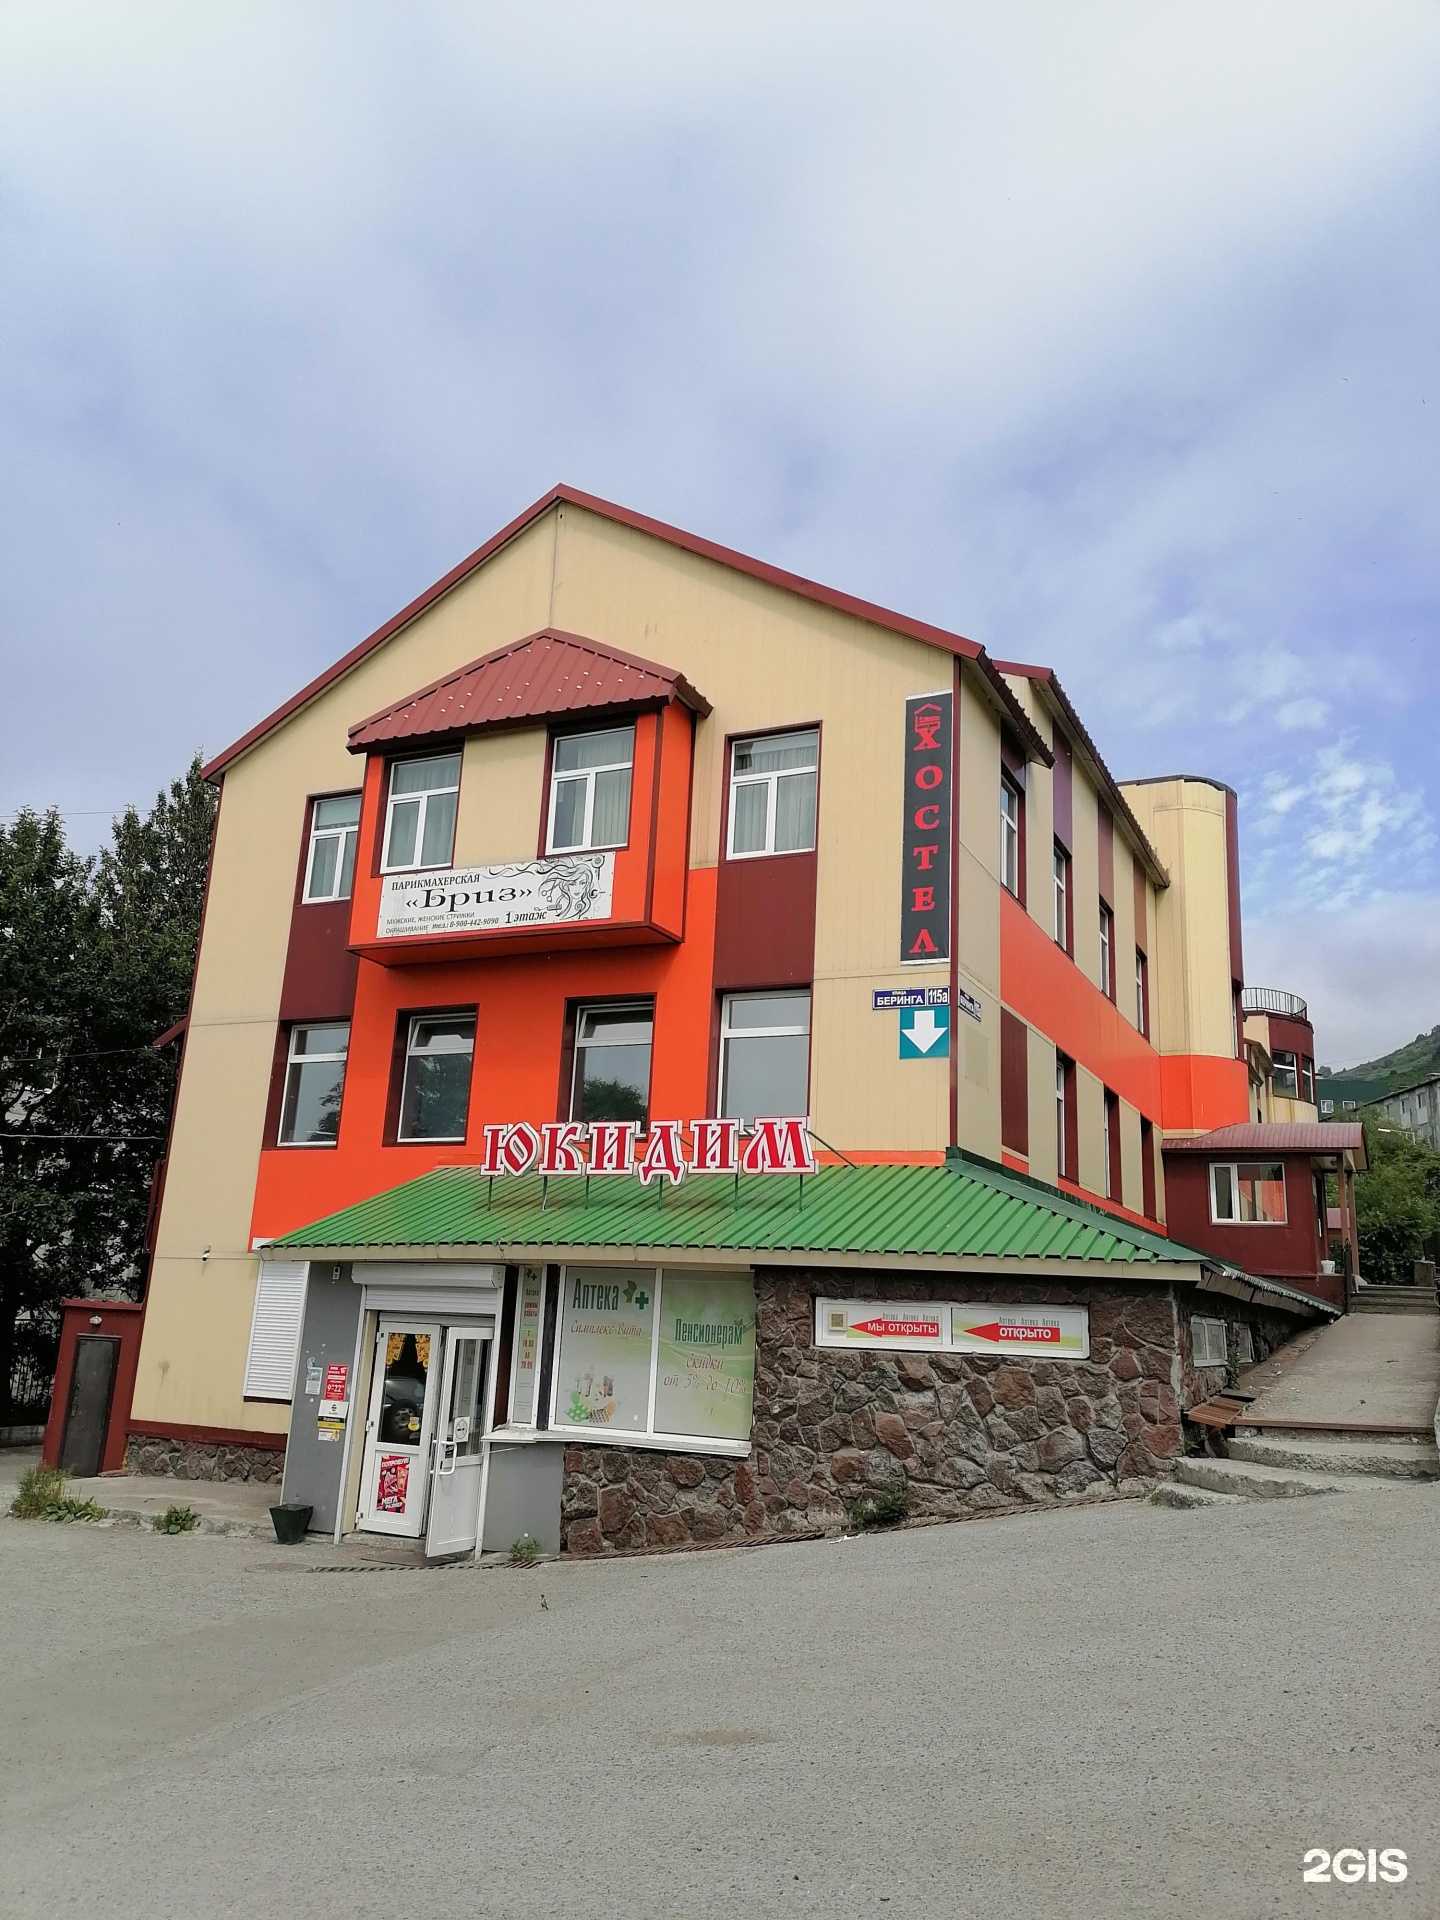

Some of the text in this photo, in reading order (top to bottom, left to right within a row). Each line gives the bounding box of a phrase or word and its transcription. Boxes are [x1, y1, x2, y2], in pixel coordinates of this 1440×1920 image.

[391, 874, 480, 891] ПАРИКМАХЕРСКАЯ
[505, 911, 547, 924] 1 этаж
[876, 995, 924, 1006] БЕРИНГА
[480, 1117, 816, 1186] ЮКИДИМ
[572, 1278, 619, 1311] Аптека
[674, 1318, 743, 1350] Пенсионерам
[888, 1323, 937, 1335] открыты
[1000, 1327, 1051, 1340] открыто
